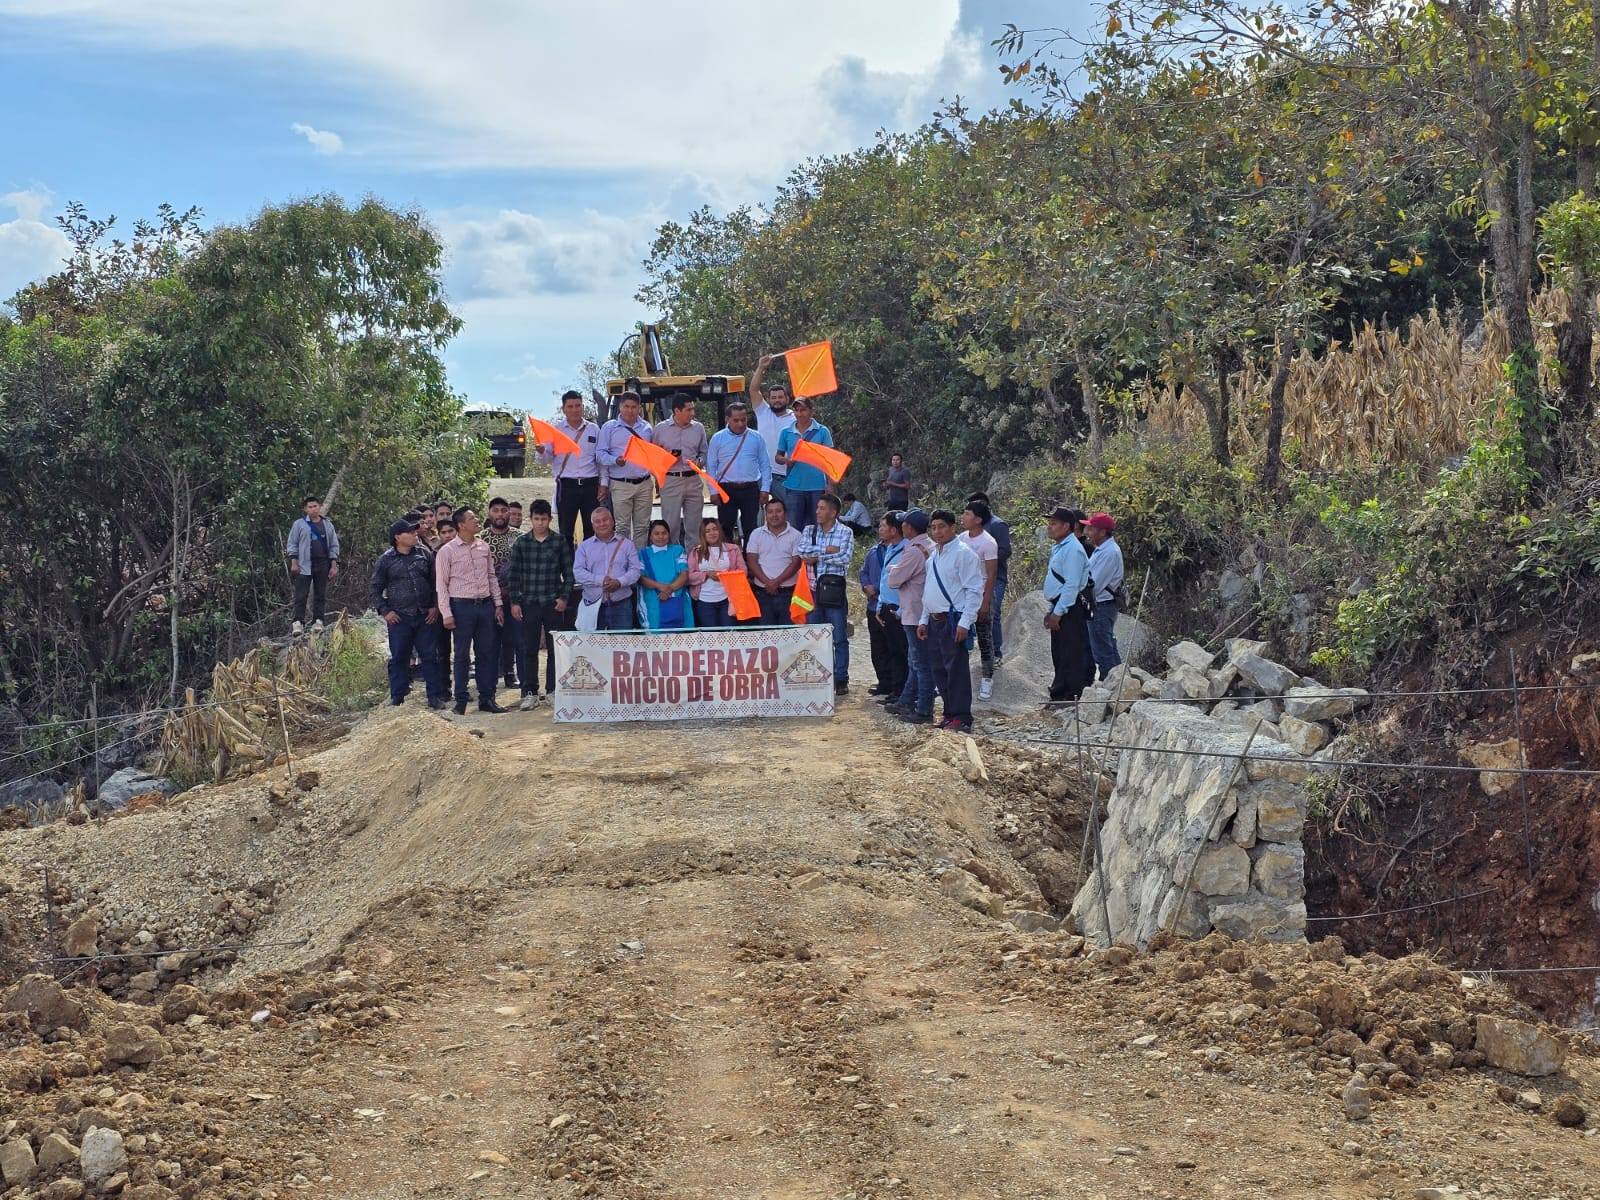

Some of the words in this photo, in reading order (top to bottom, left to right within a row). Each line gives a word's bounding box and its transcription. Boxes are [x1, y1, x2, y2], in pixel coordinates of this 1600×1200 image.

[612, 646, 779, 677] BANDERAZO
[611, 677, 681, 705] INICIO
[687, 675, 714, 702] DE
[719, 672, 780, 701] OBRA
